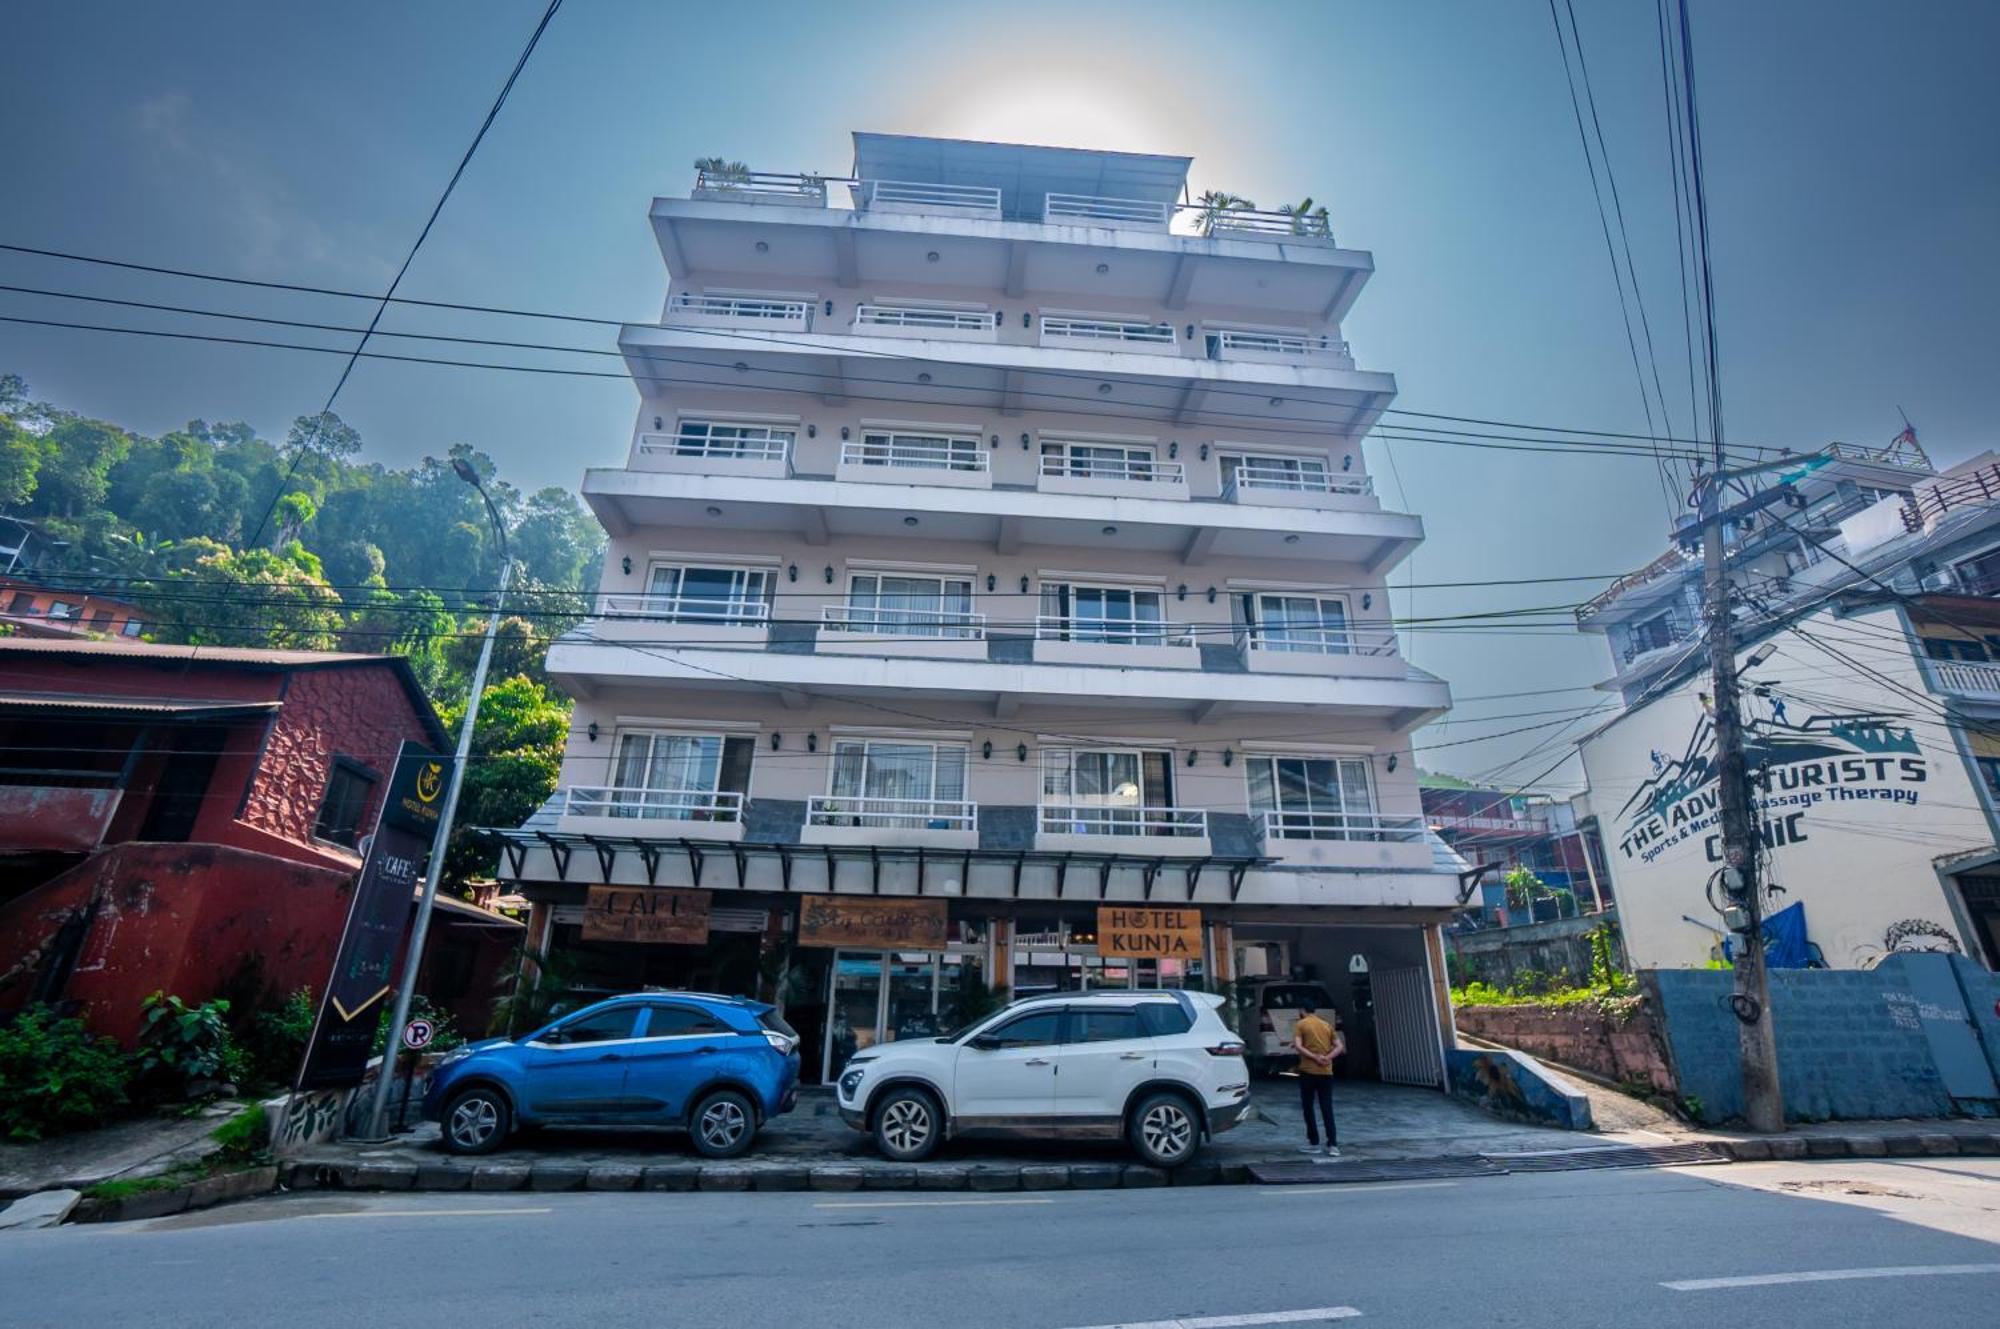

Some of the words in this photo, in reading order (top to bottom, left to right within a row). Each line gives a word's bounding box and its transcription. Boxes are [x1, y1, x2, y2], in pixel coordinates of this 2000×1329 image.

[1640, 833, 1679, 864] Sports
[1679, 827, 1690, 839] &
[1825, 787, 1919, 805] Therapy
[1619, 818, 1664, 859] THE
[385, 855, 410, 878] CAFE
[1112, 909, 1187, 929] HOTEL
[1112, 933, 1188, 955] KUNJA
